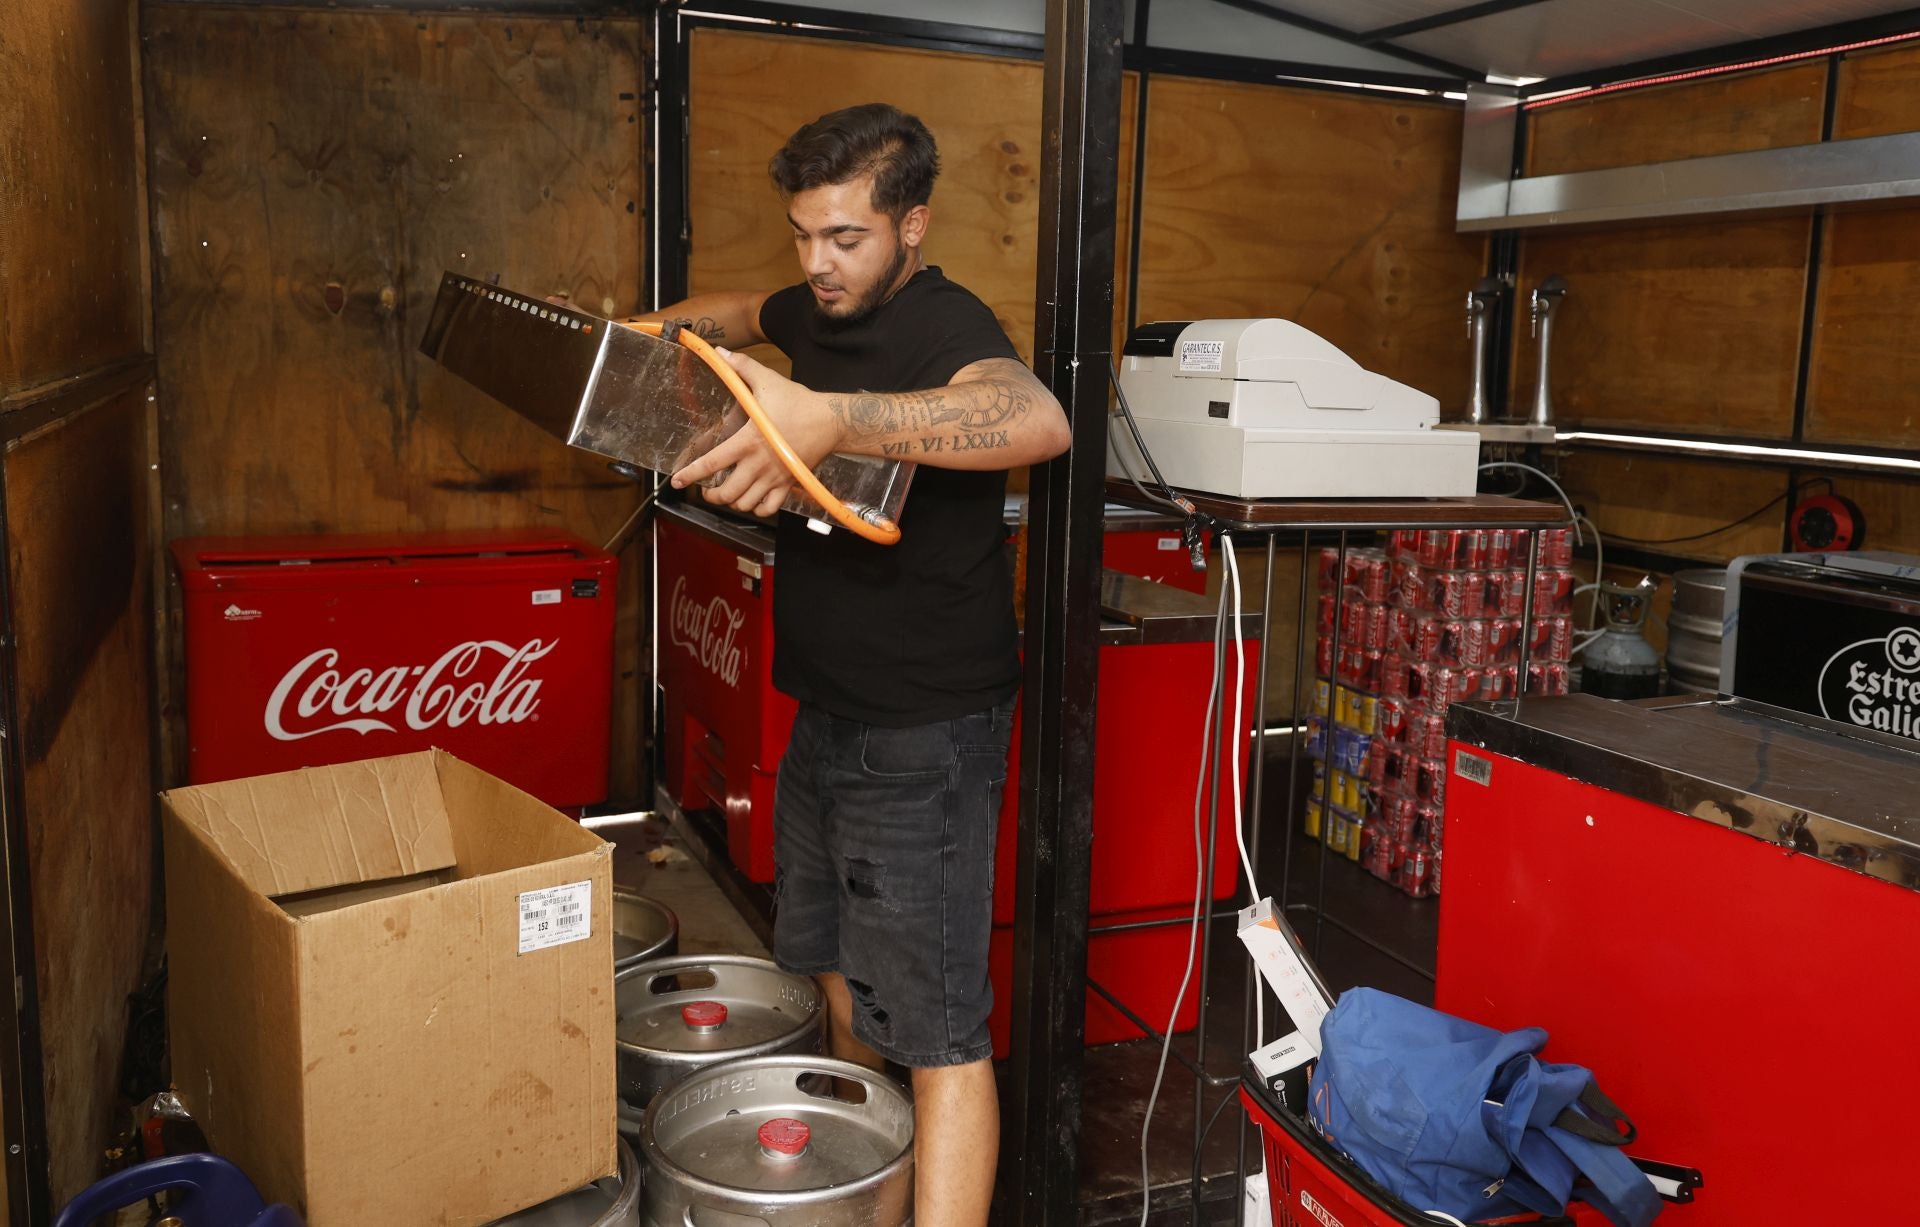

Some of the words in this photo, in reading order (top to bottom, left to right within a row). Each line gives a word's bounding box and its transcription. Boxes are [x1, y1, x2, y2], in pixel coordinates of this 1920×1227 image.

[920, 436, 944, 453] VI
[952, 430, 1010, 452] LXXIX
[670, 575, 745, 688] Coca-Cola
[263, 637, 560, 741] Coca-Cola
[537, 921, 549, 932] 152
